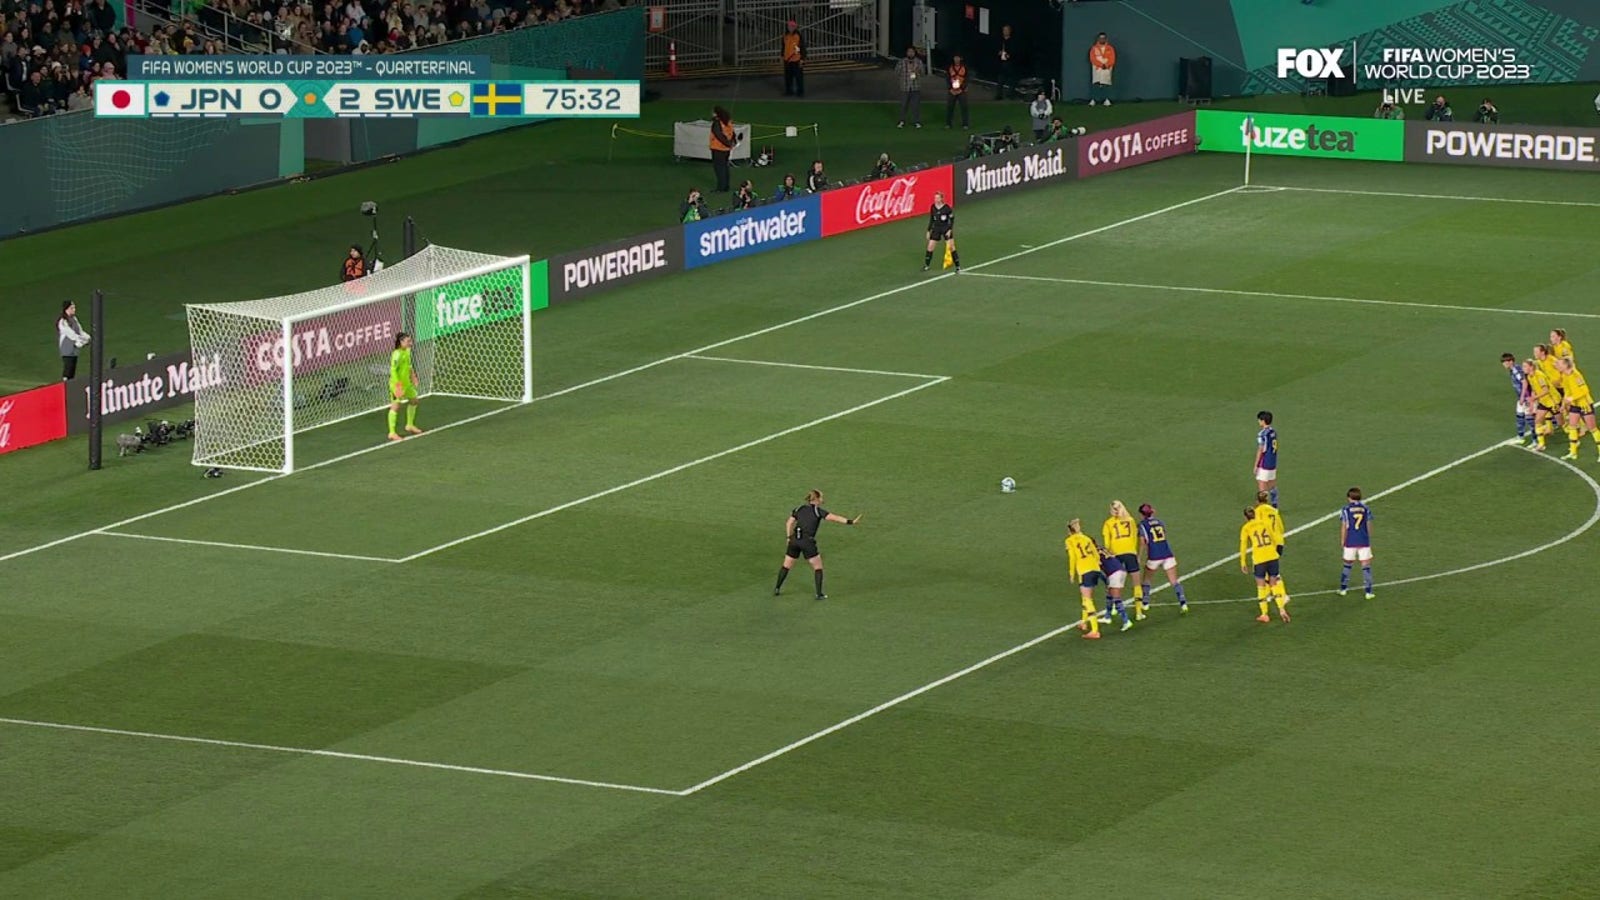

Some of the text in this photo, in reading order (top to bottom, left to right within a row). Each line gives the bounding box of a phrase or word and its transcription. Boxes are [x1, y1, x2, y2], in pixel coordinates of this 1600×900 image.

[1087, 128, 1188, 166] COSTA COFFEE
[1426, 129, 1595, 162] POWERADE
[965, 148, 1064, 195] Minute Maid
[699, 209, 806, 256] smartwater
[563, 239, 666, 292] POWERADE
[334, 321, 391, 351] COFFEE
[166, 354, 222, 399] Maid
[1112, 520, 1131, 539] 13
[1149, 525, 1166, 542] 13
[1353, 513, 1363, 530] 7
[1076, 541, 1094, 559] 14
[1253, 528, 1272, 548] 16
